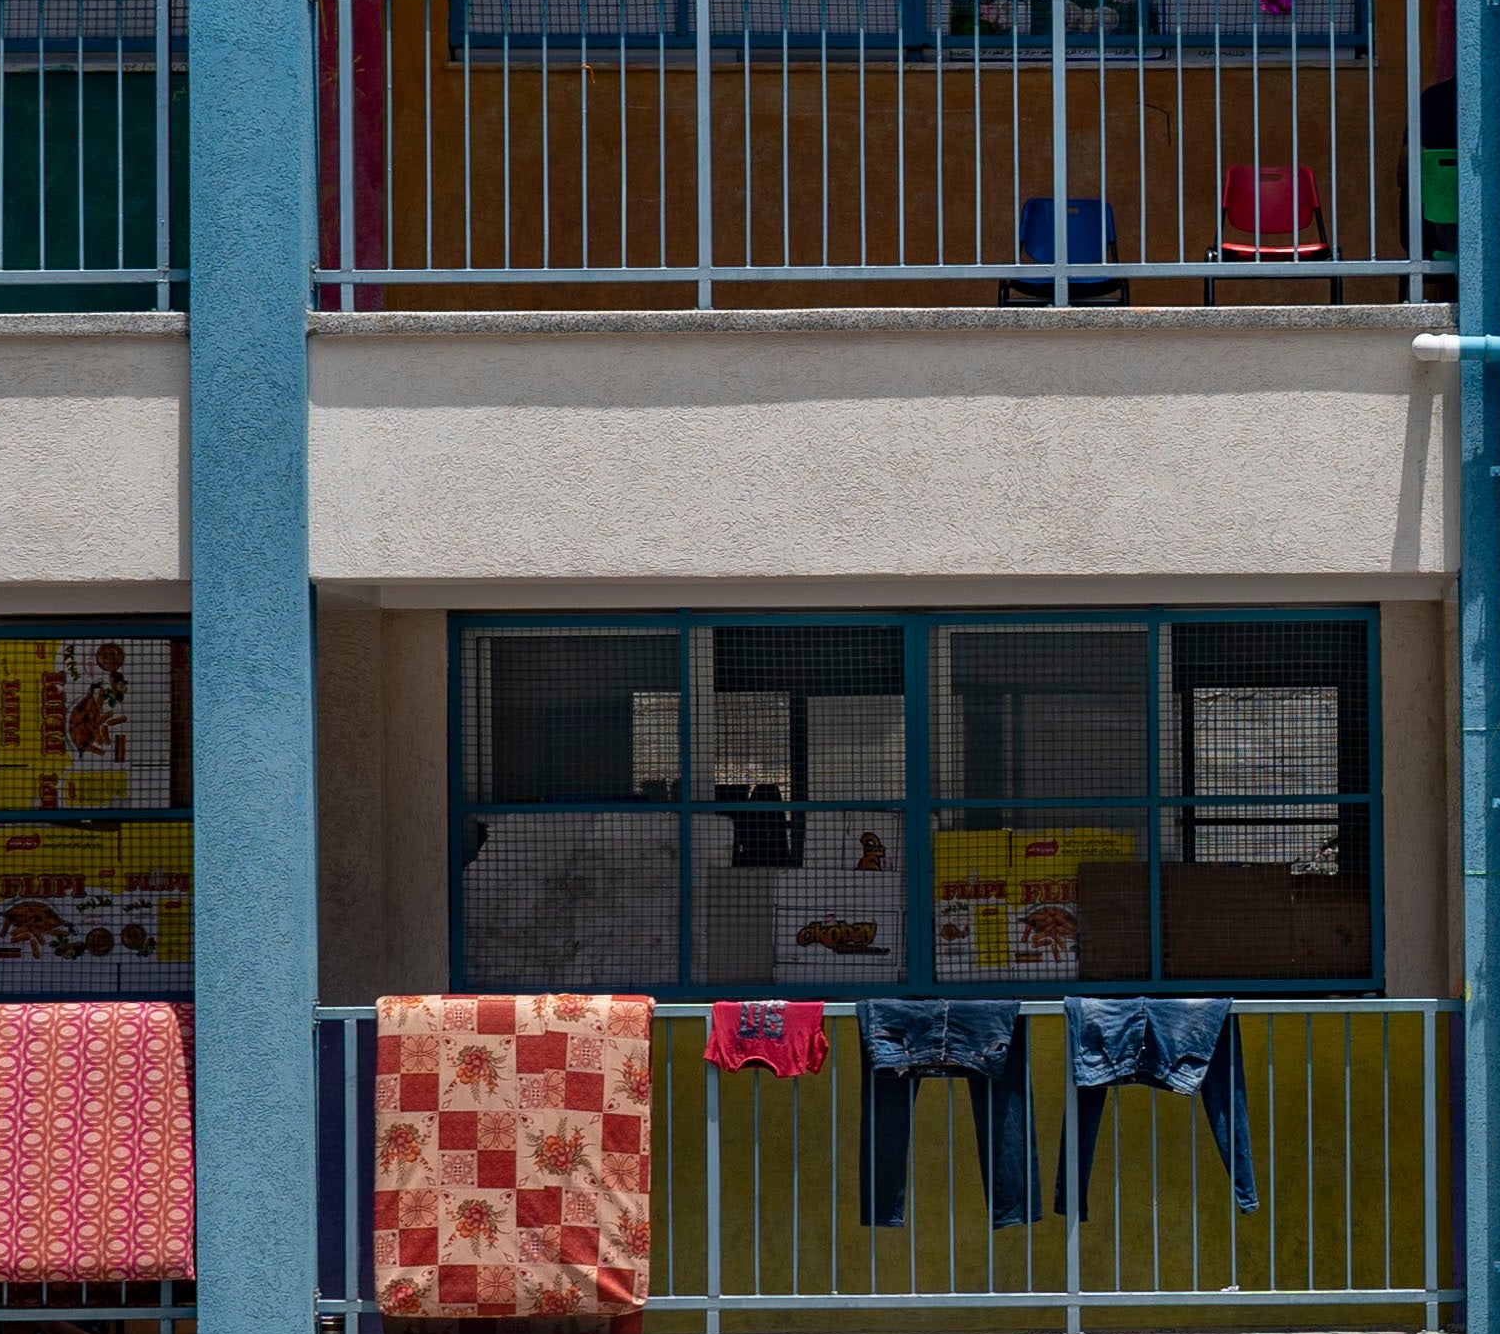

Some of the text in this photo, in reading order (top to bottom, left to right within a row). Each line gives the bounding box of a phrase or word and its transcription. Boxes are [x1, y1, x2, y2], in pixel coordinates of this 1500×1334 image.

[0, 679, 20, 747] FLIPI
[40, 671, 66, 756] FLIPI
[0, 873, 87, 898] FLIPI
[941, 880, 1008, 900] FLIPI
